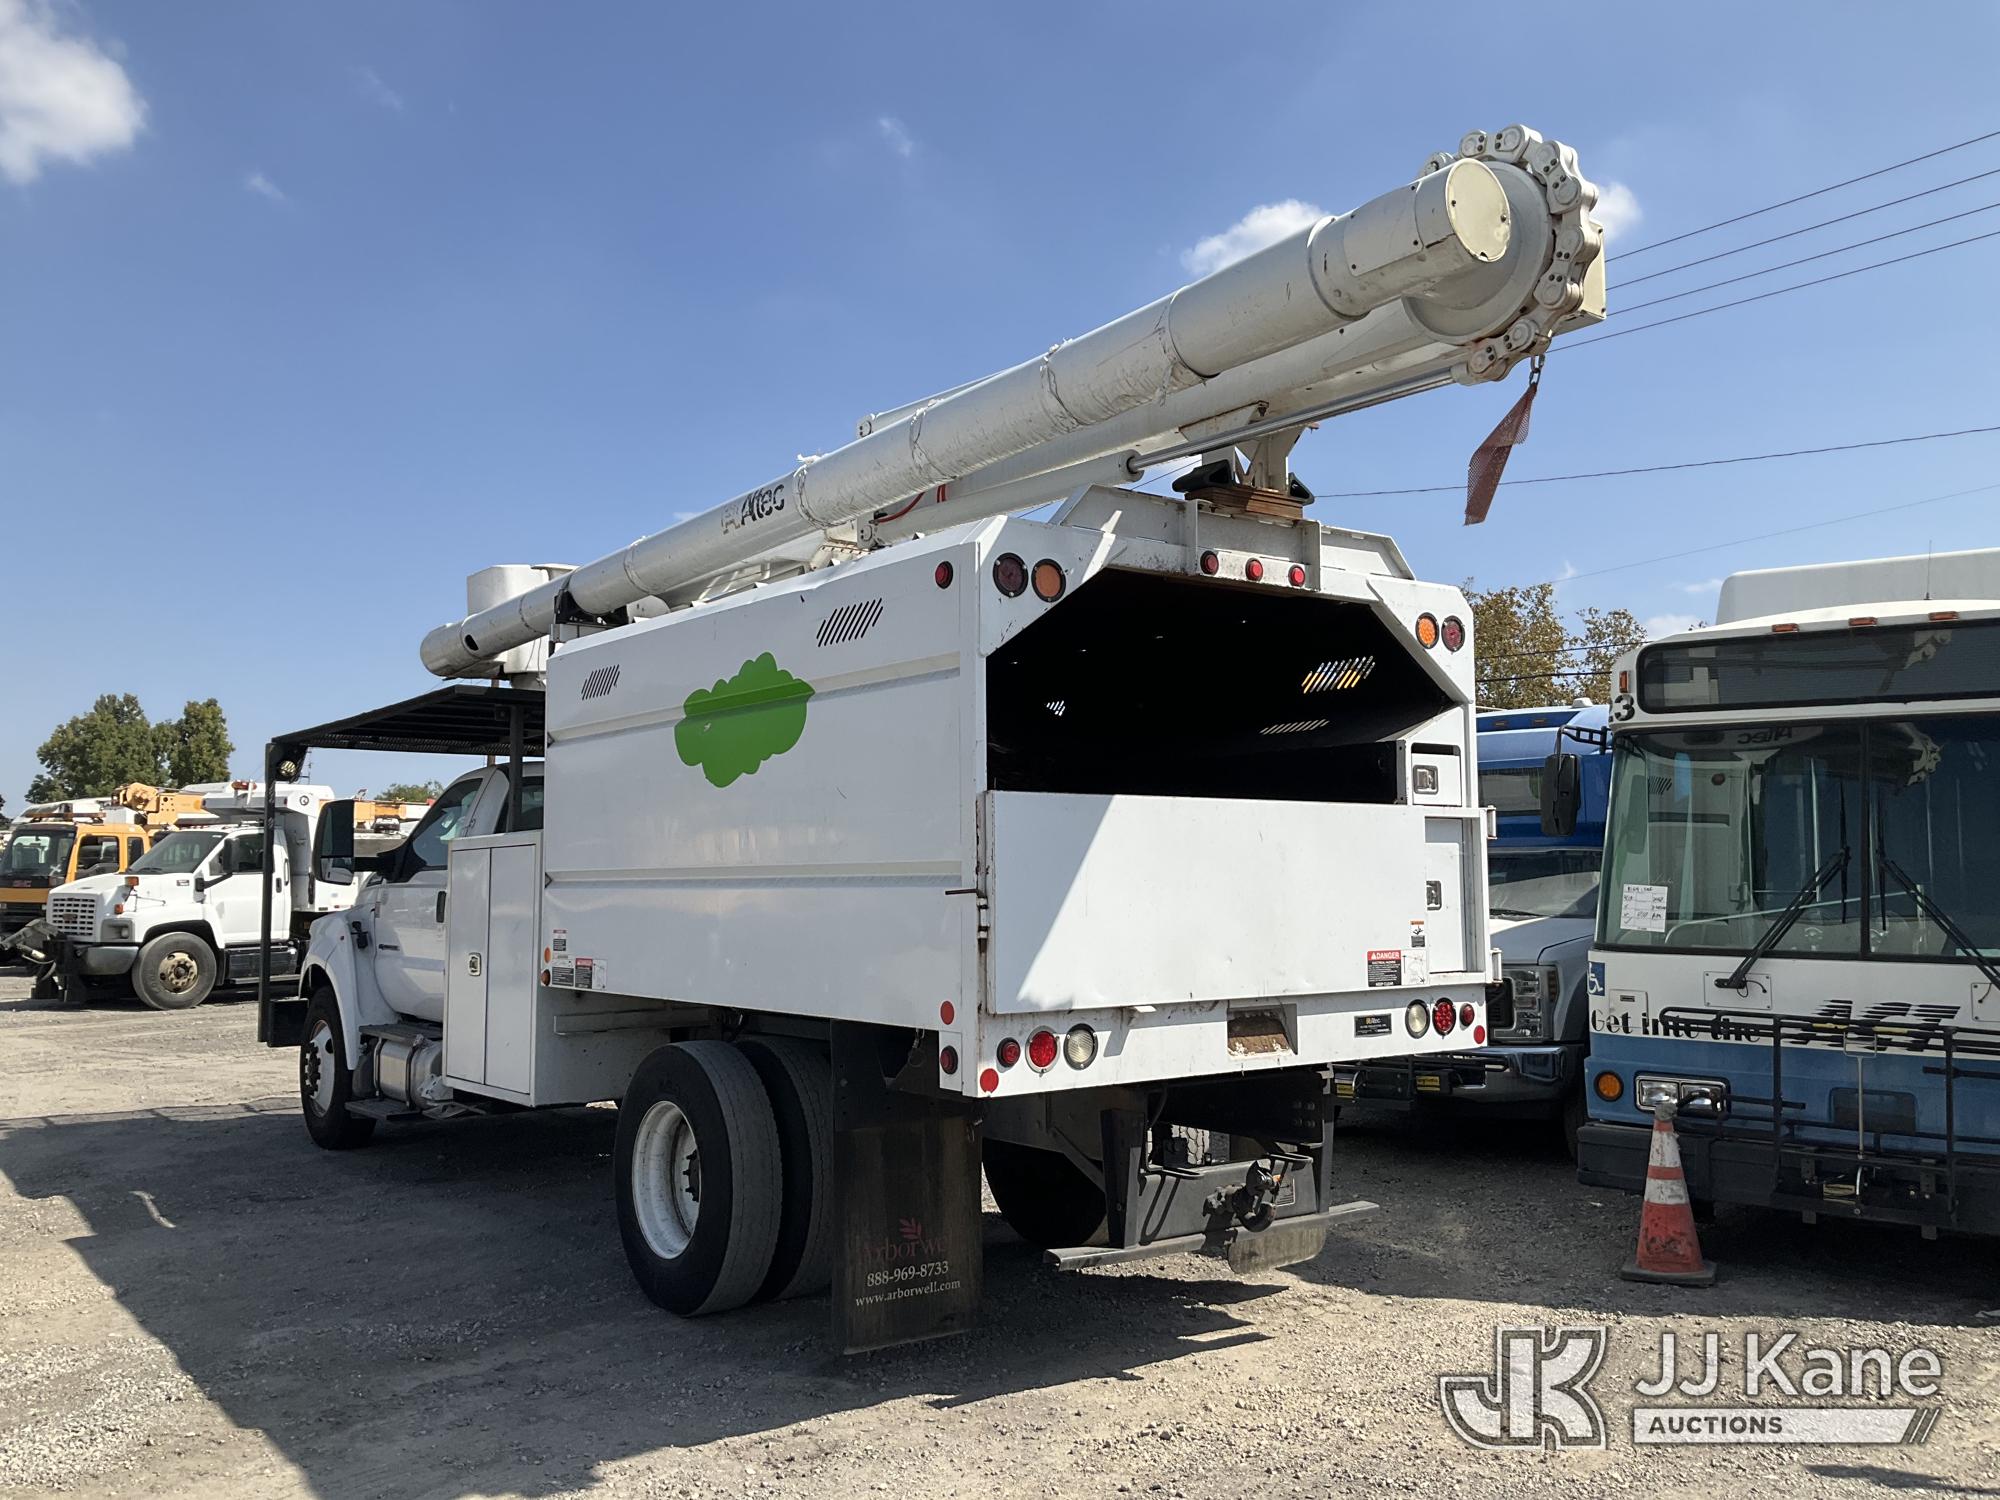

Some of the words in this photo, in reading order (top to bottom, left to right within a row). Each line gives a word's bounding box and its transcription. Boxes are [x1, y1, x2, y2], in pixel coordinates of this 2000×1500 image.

[741, 484, 785, 525] Altec
[1609, 694, 1636, 722] 3
[1376, 951, 1400, 960] DANGER
[1591, 1009, 1633, 1034] Get
[867, 1260, 949, 1287] 888-969-8733
[856, 1280, 961, 1307] www.arborwell.com
